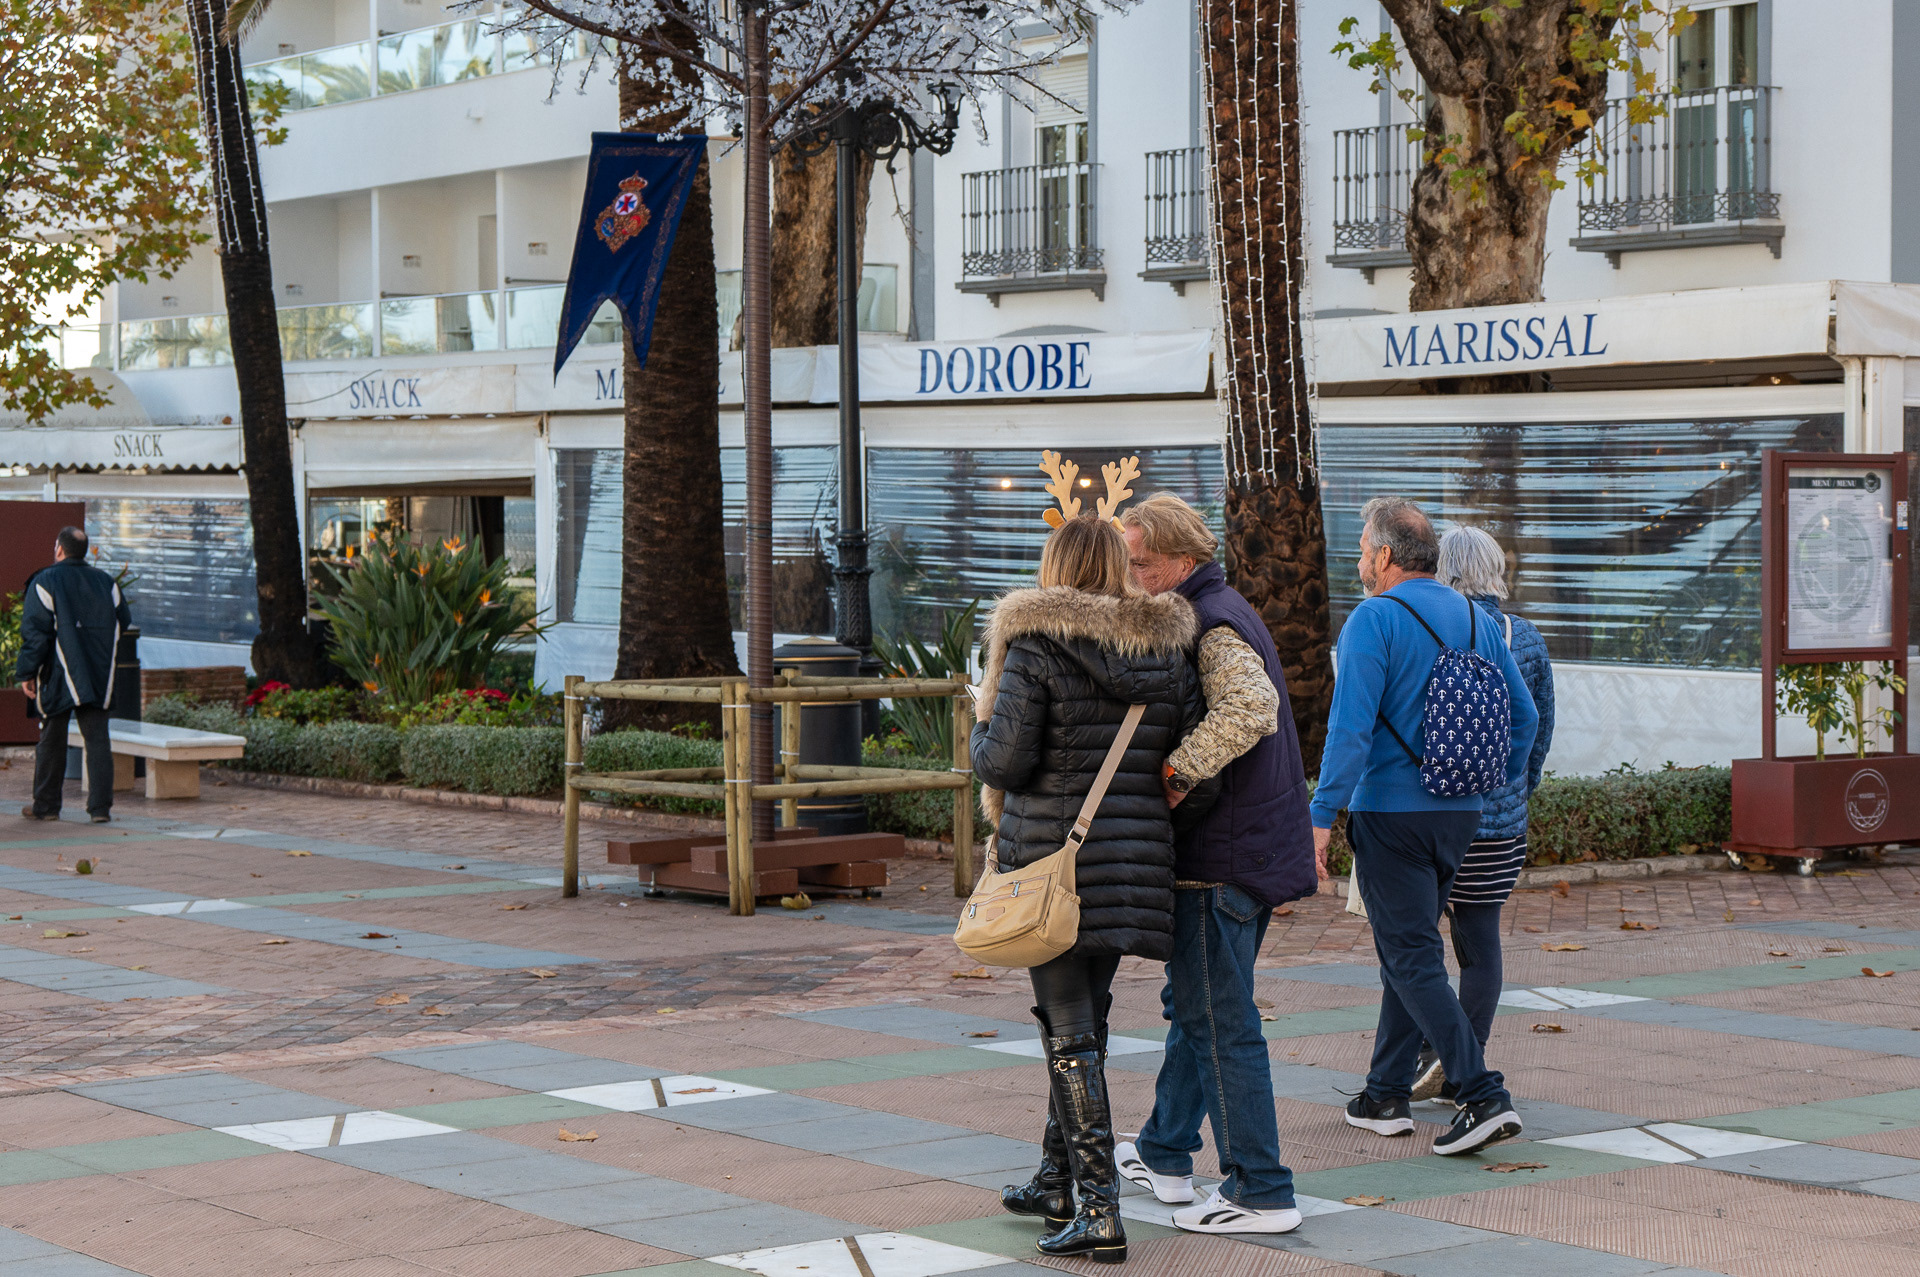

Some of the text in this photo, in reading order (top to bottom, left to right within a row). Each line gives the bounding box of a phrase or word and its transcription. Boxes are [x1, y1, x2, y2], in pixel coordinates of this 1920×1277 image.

[1382, 313, 1608, 368] MARISSAL
[915, 341, 1092, 394] DOROBE
[350, 377, 422, 410] SNACK
[114, 434, 163, 457] SNACK
